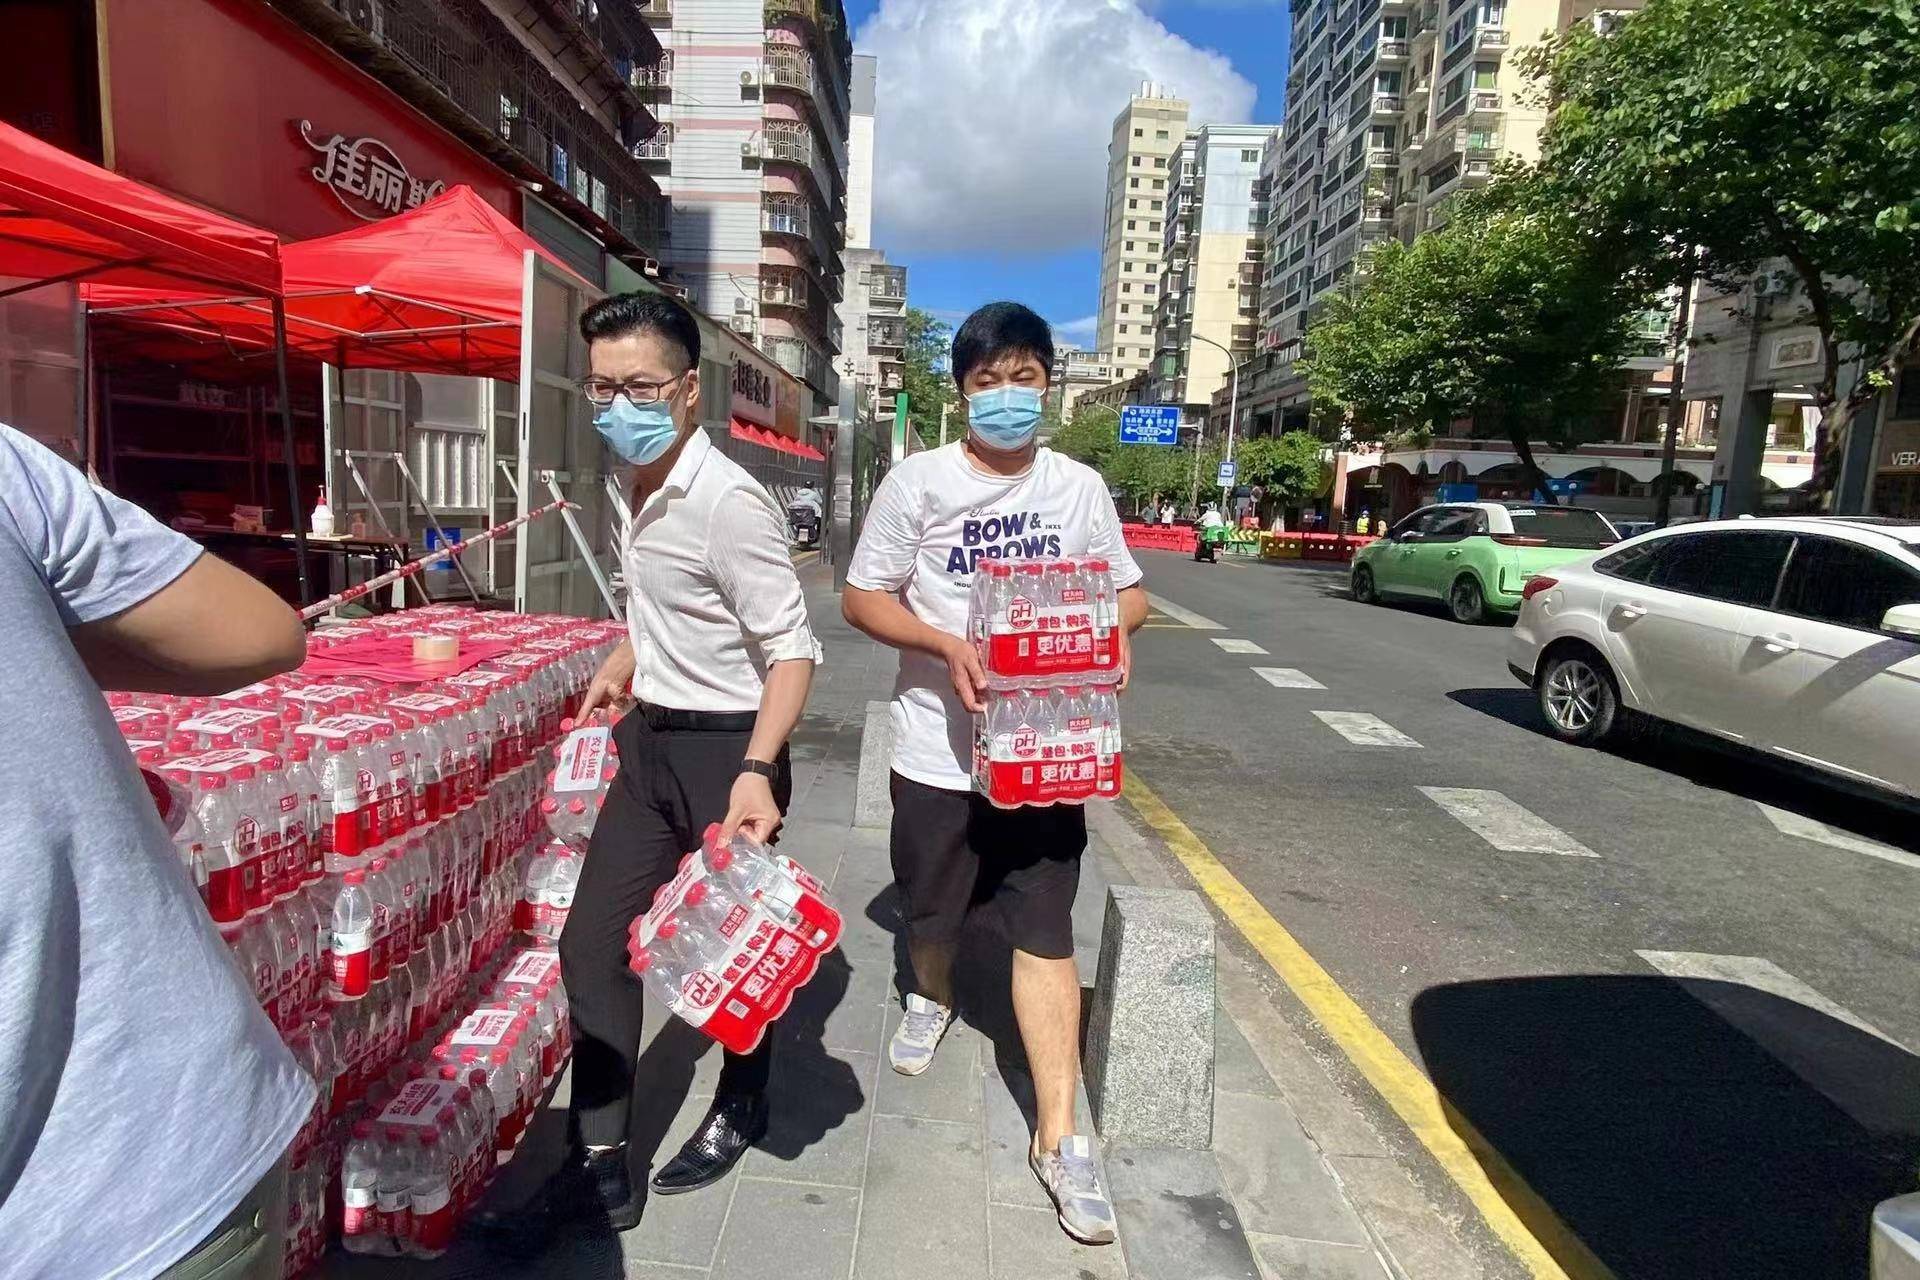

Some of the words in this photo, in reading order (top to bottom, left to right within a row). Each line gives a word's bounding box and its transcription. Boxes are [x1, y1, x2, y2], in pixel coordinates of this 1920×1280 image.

[1891, 451, 1920, 466] VER
[963, 511, 1027, 547] BOW
[1029, 512, 1042, 530] &
[1011, 604, 1032, 622] pH
[1037, 633, 1092, 656] 更优惠
[1014, 734, 1036, 751] pH
[1040, 761, 1096, 784] 更优惠
[739, 932, 801, 1003] 更优惠
[690, 972, 715, 1006] pH
